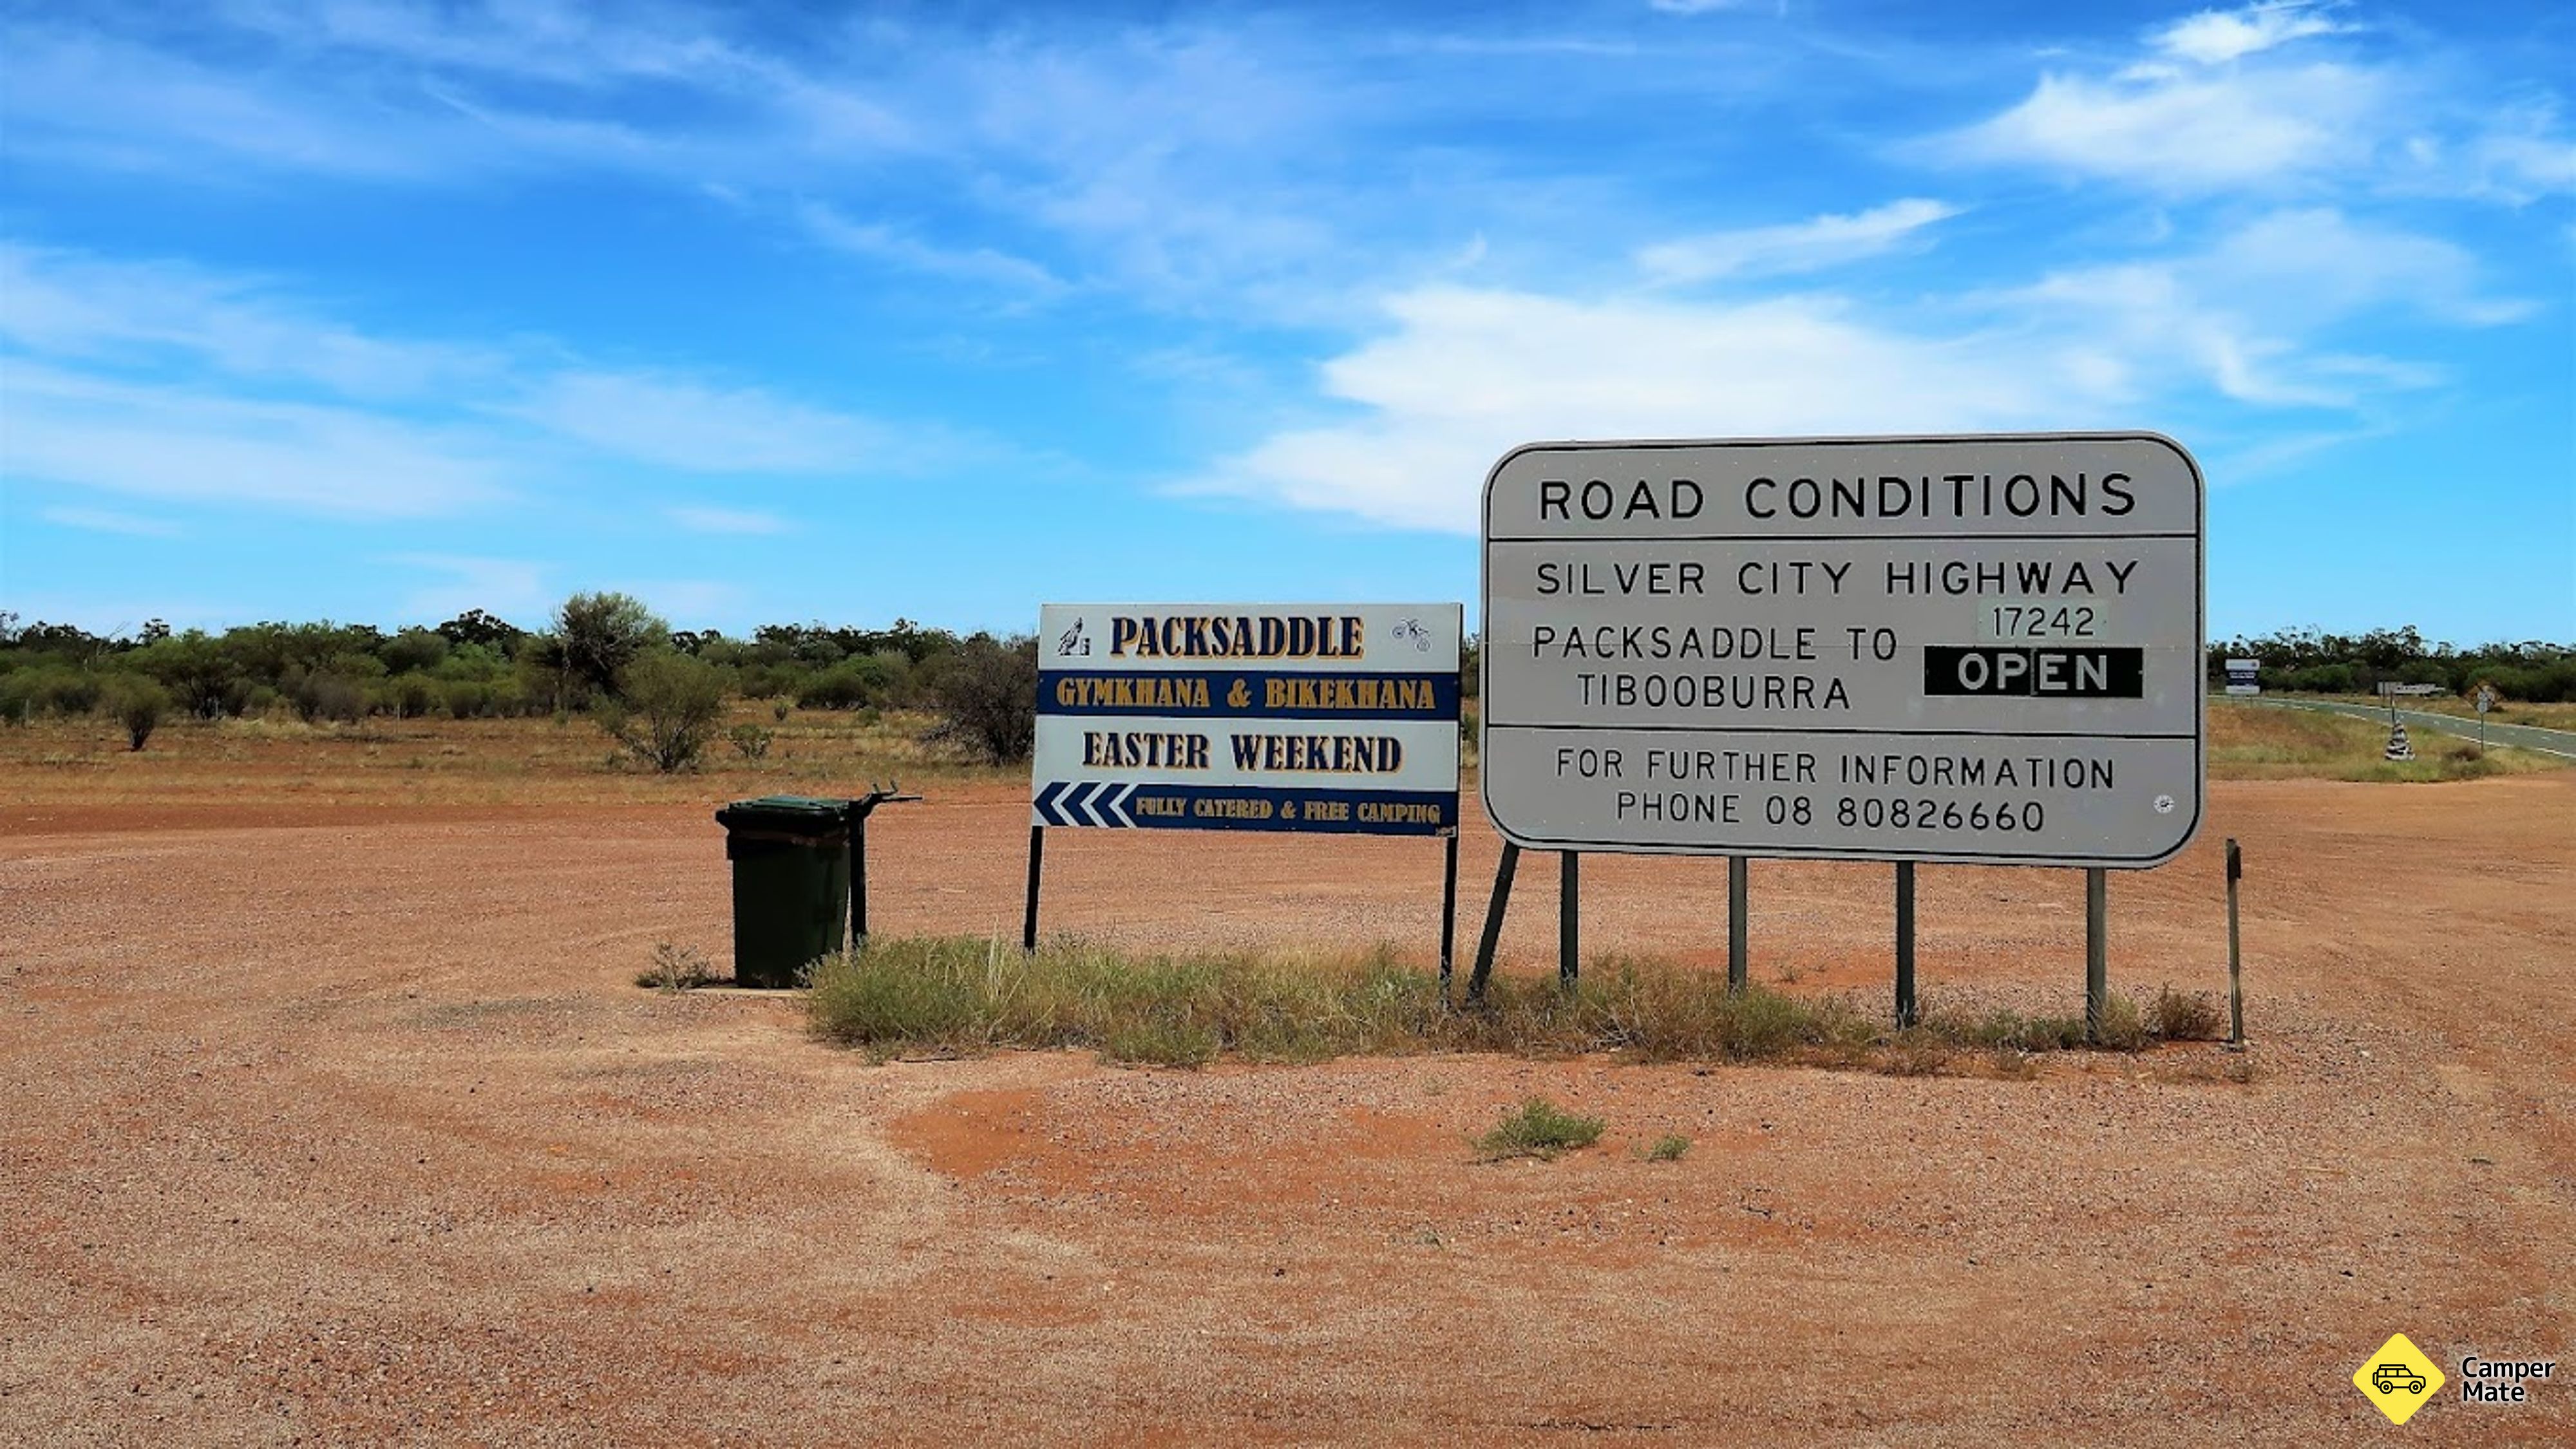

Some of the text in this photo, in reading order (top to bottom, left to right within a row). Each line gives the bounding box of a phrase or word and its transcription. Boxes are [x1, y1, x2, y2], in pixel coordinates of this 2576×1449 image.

[1541, 473, 2136, 520] ROAD CONDITIONS
[1537, 560, 2139, 595] SILVER CITY HIGHWAY
[1110, 616, 1365, 660] PACKSADDLE
[1993, 607, 2094, 636] 17242
[1533, 626, 1897, 661] PACKSADDLE TO
[1958, 653, 2108, 690] OPEN
[1057, 678, 1435, 709] GYMKHANA & BIKEKHANA
[1577, 674, 1850, 710] TIBOOBURRA
[1083, 732, 1403, 773] EASTER WEEKEND
[1558, 748, 2114, 790] FOR FURTHER INFORMATION
[1136, 798, 1441, 824] FULLY CATERED & FREE CAMPING
[1618, 791, 2045, 833] PHONE 08 80826660
